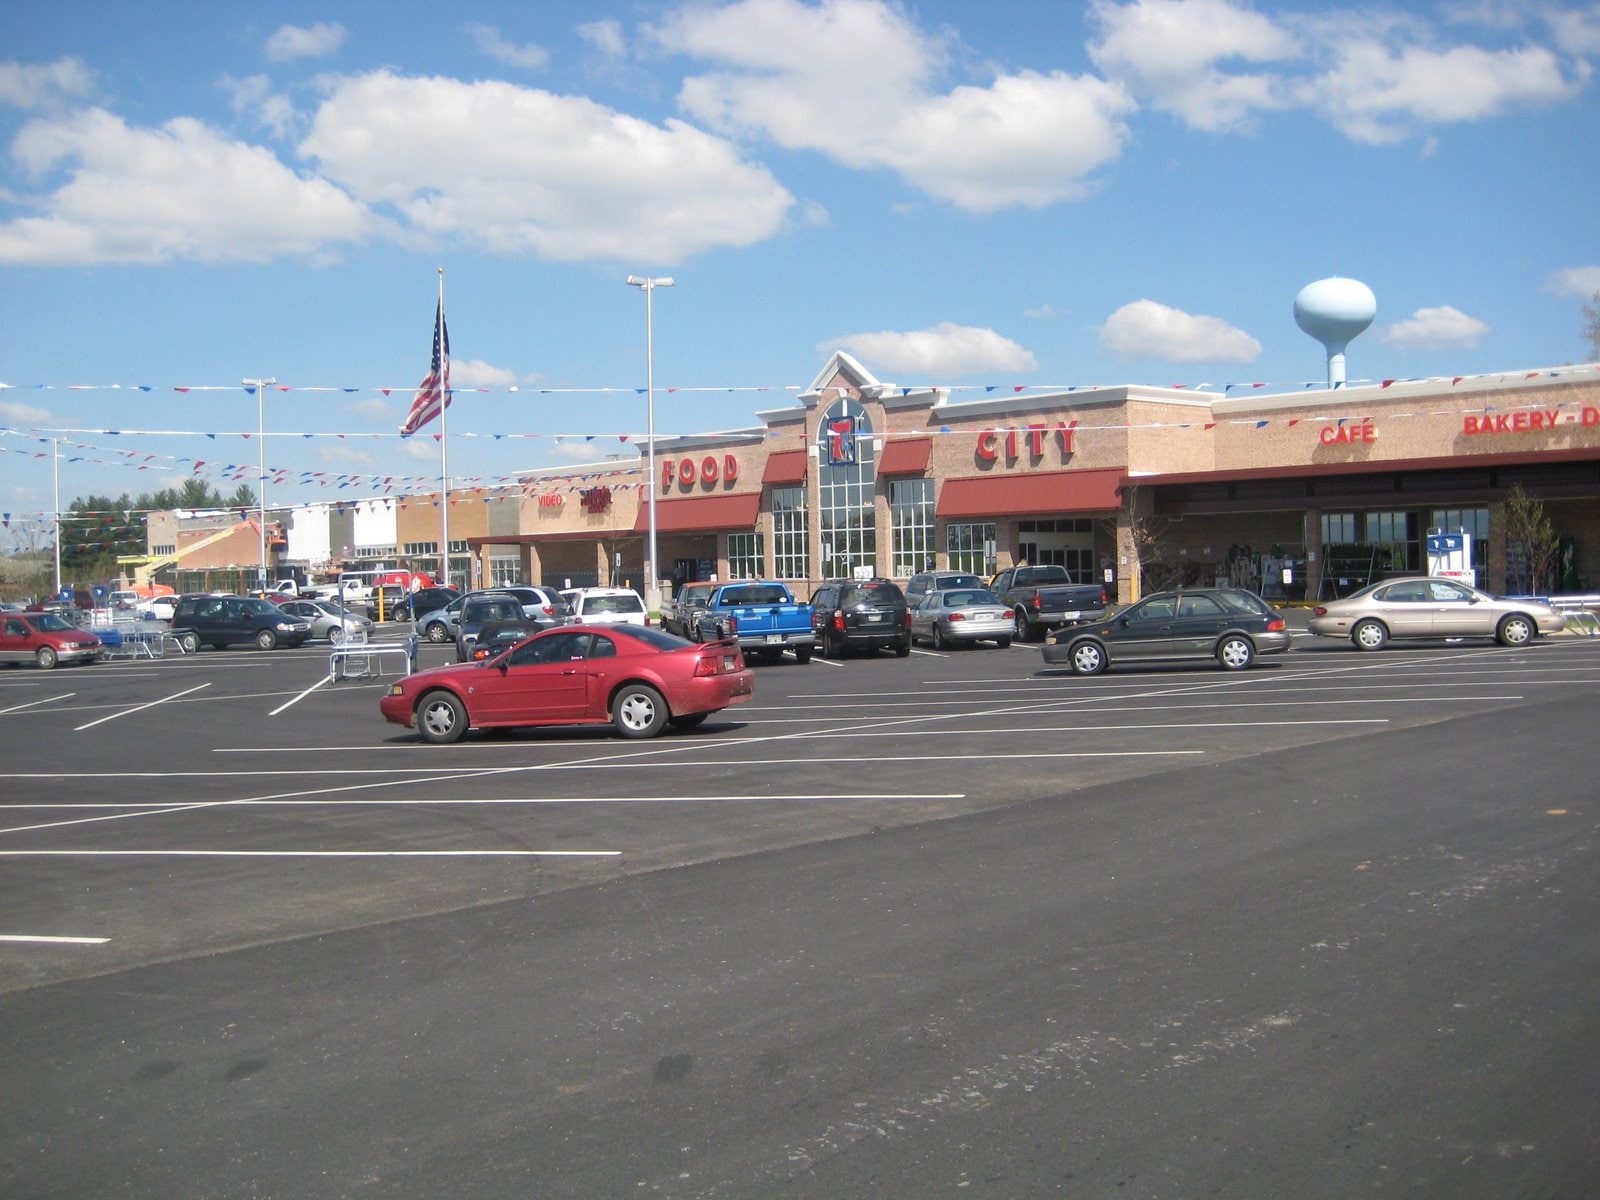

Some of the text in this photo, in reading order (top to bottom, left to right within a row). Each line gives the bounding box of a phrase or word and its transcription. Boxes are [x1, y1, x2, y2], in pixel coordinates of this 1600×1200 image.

[977, 421, 1078, 460] CITY
[662, 454, 738, 486] FOOD
[537, 495, 562, 506] VIDEO
